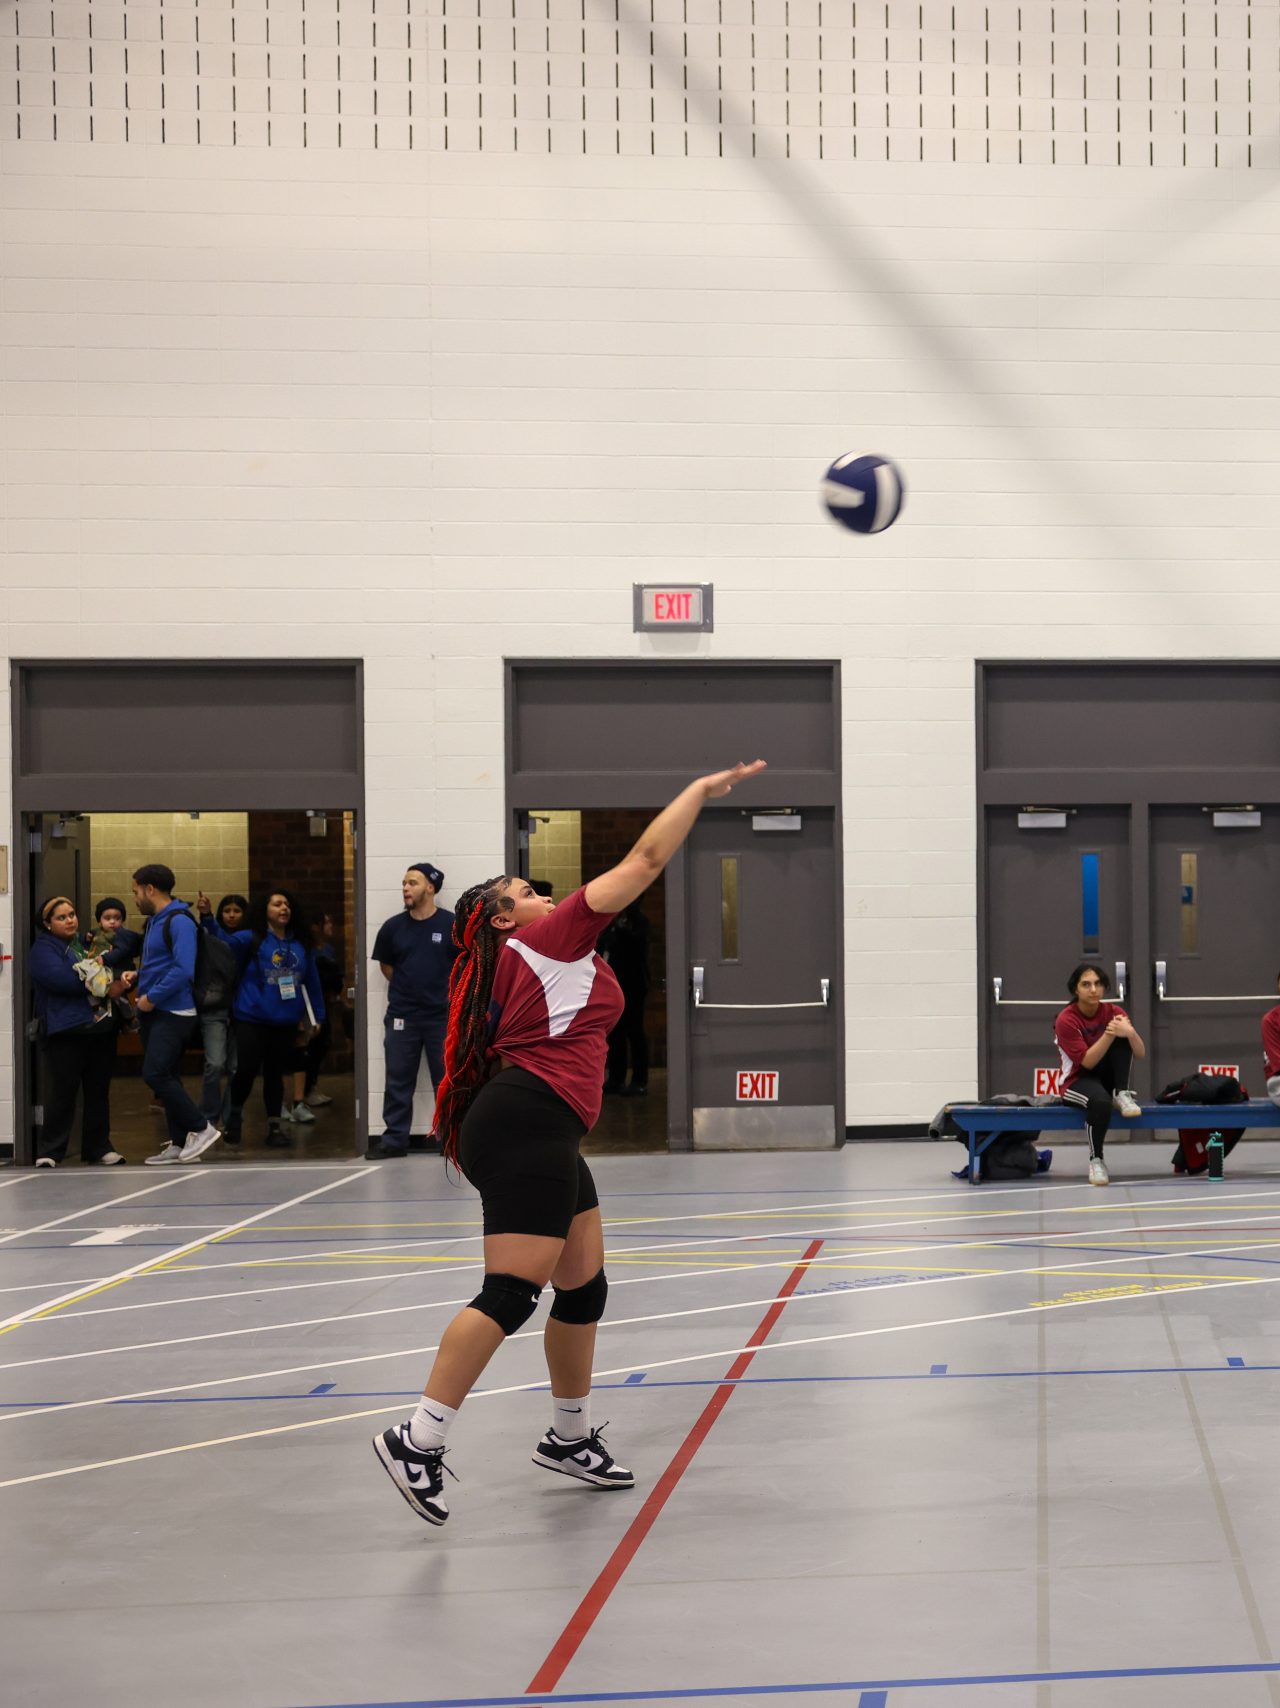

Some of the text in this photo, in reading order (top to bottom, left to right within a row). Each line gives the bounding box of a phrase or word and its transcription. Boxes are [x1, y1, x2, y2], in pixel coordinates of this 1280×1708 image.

[654, 593, 692, 620] EXIT
[738, 1073, 776, 1099] EXIT
[1036, 1070, 1059, 1095] EX
